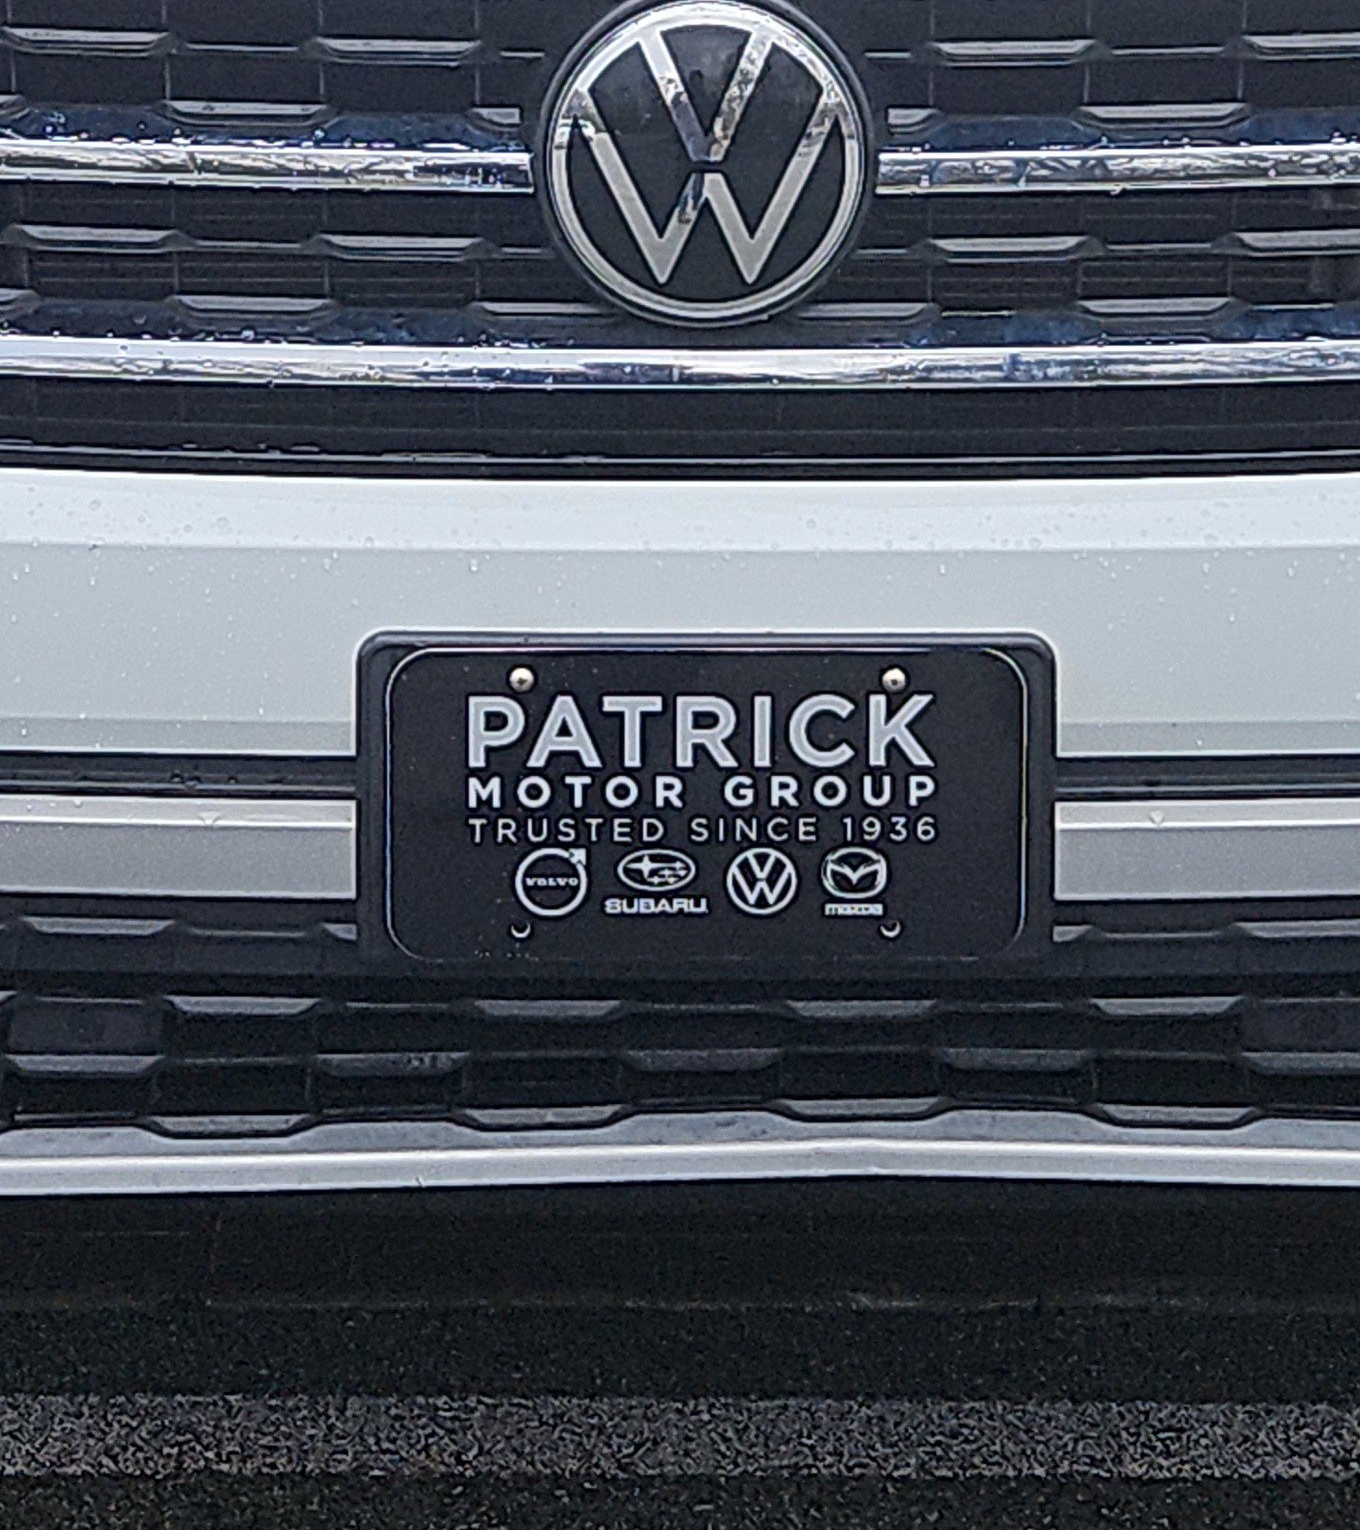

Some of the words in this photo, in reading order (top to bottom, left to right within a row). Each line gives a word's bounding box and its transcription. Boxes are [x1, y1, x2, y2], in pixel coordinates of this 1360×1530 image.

[468, 694, 936, 768] PATRICK
[468, 775, 684, 808] MOTOR
[724, 775, 936, 807] GROUP
[468, 818, 665, 843] TRUSTED
[690, 817, 817, 842] SINCE
[843, 817, 936, 842] 1936
[525, 876, 580, 887] VOLVO
[604, 897, 709, 914] SUBARU
